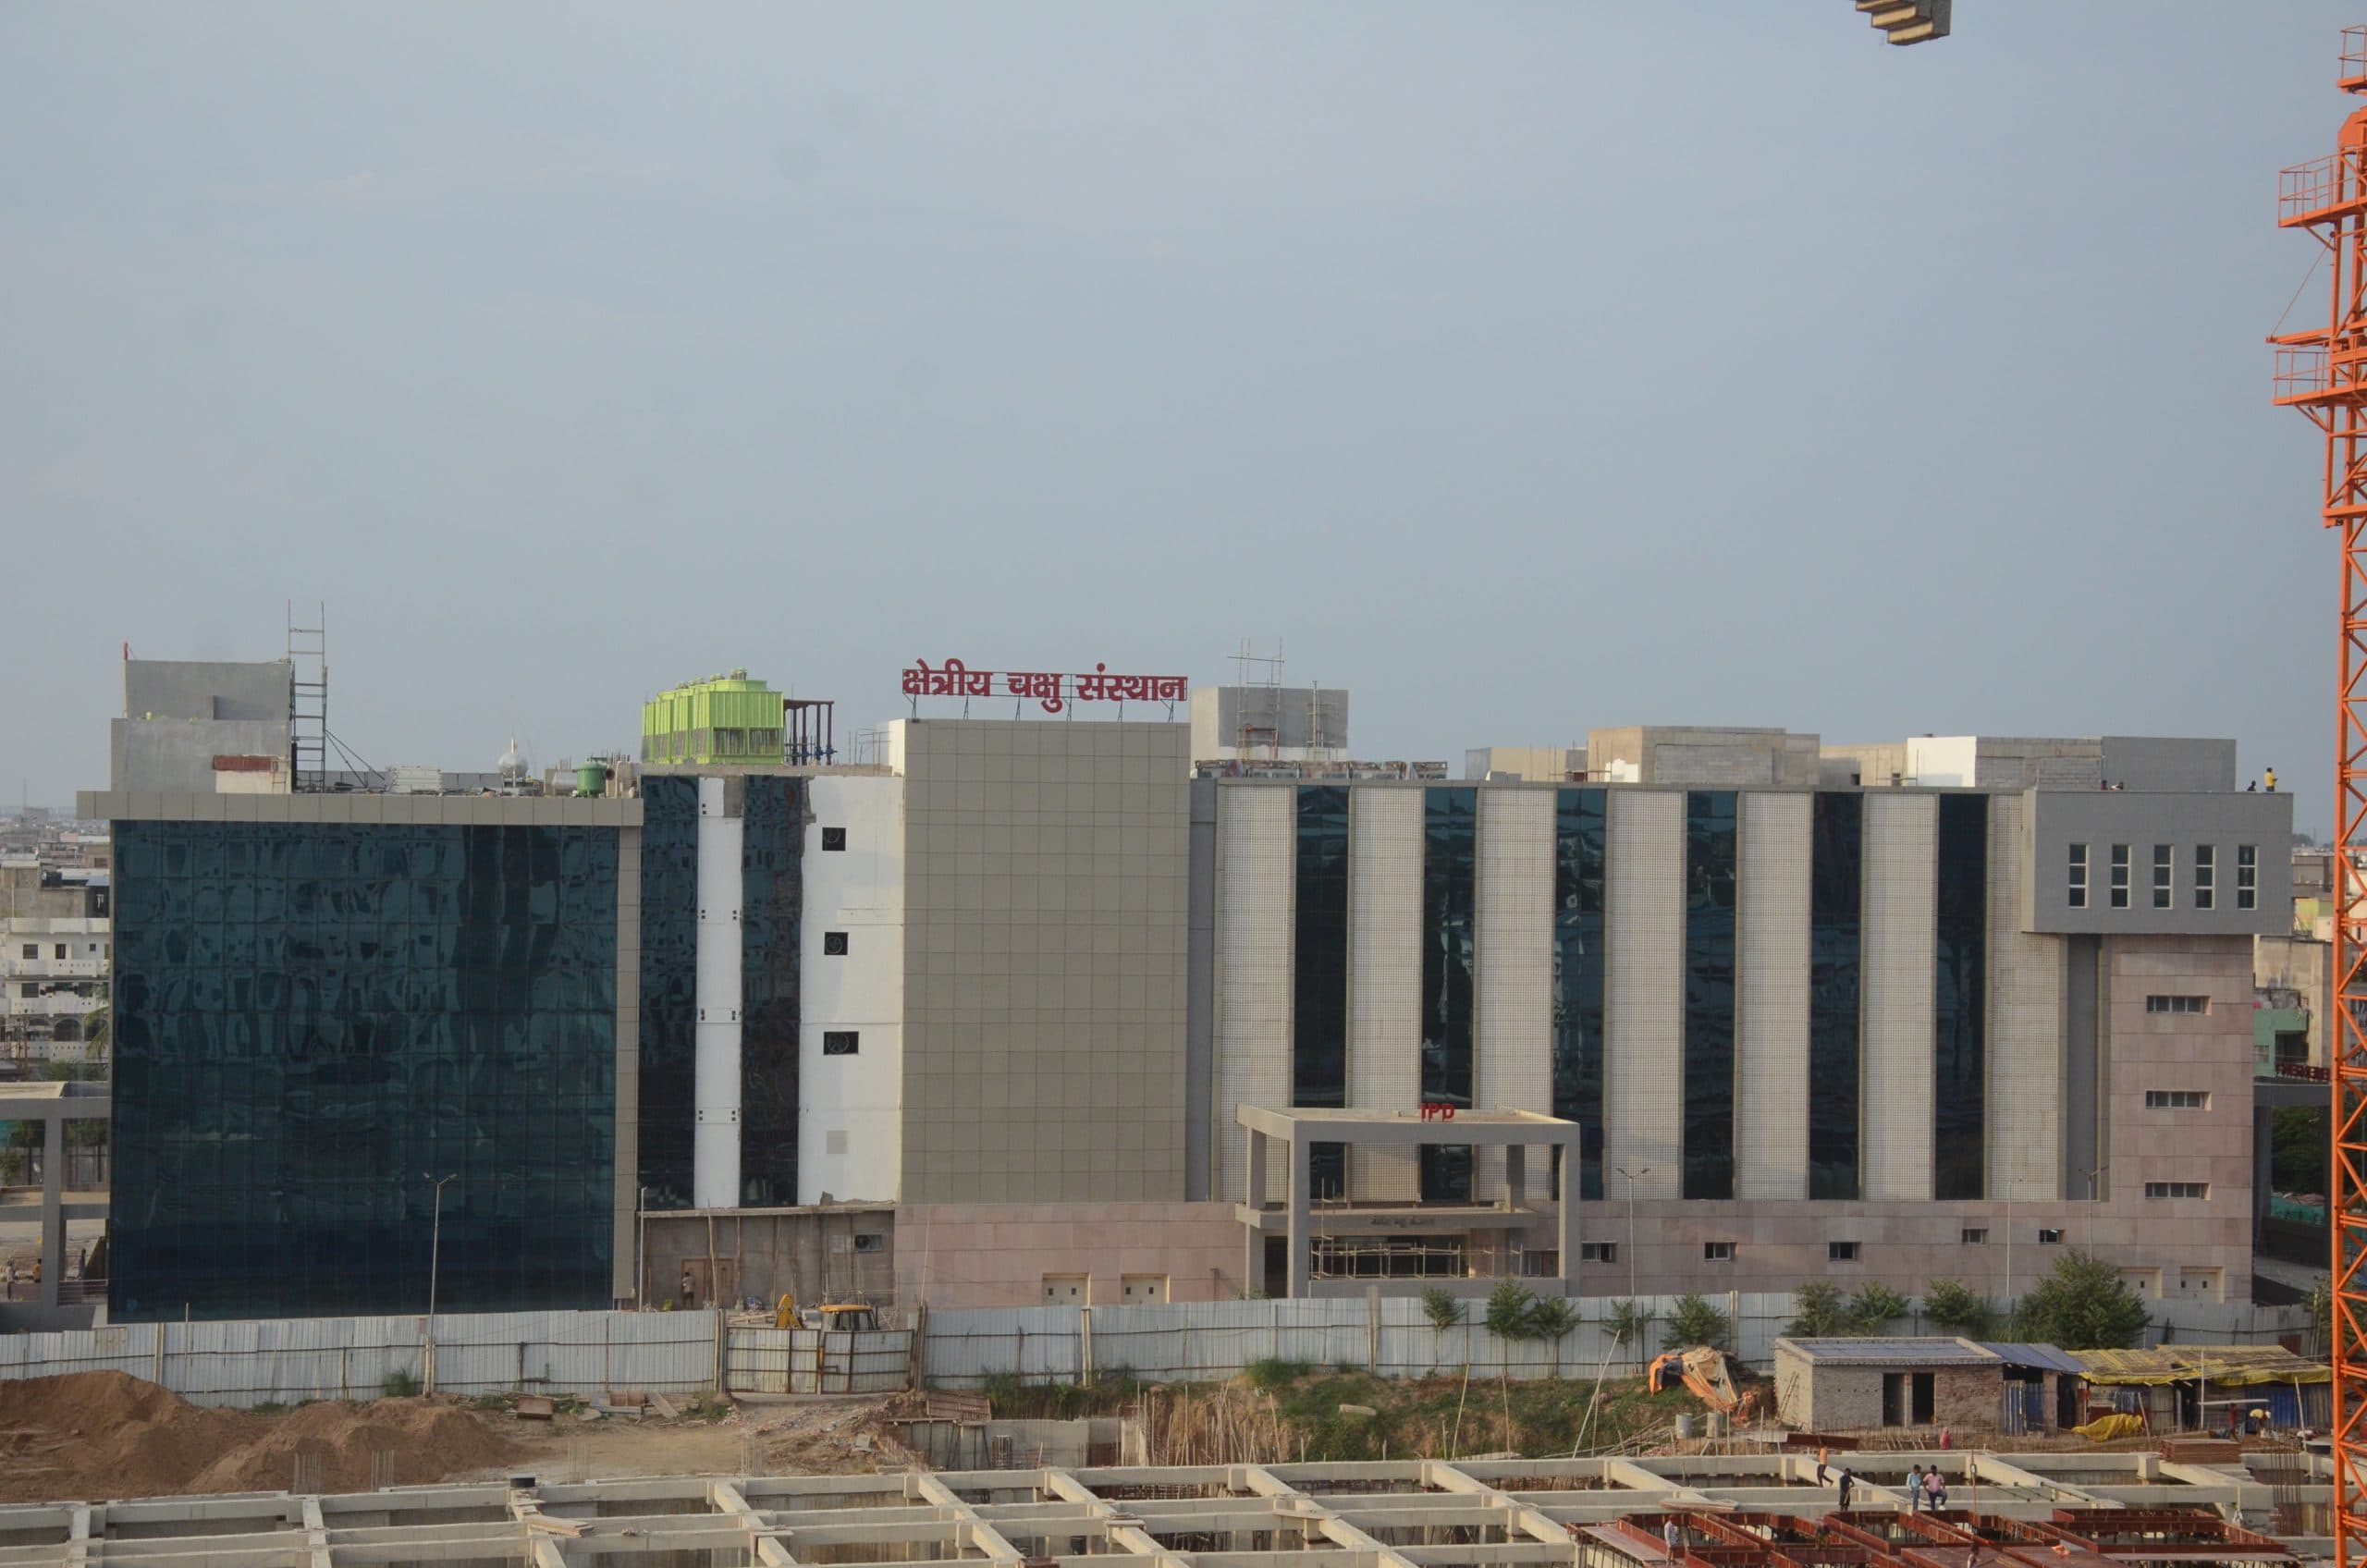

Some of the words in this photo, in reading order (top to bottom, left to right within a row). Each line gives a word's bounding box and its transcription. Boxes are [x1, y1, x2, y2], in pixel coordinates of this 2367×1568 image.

[902, 658, 992, 696] क्षेत्रीय
[1007, 672, 1063, 713] चक्षु
[1076, 663, 1187, 701] संस्थान
[1420, 1103, 1455, 1121] IPD
